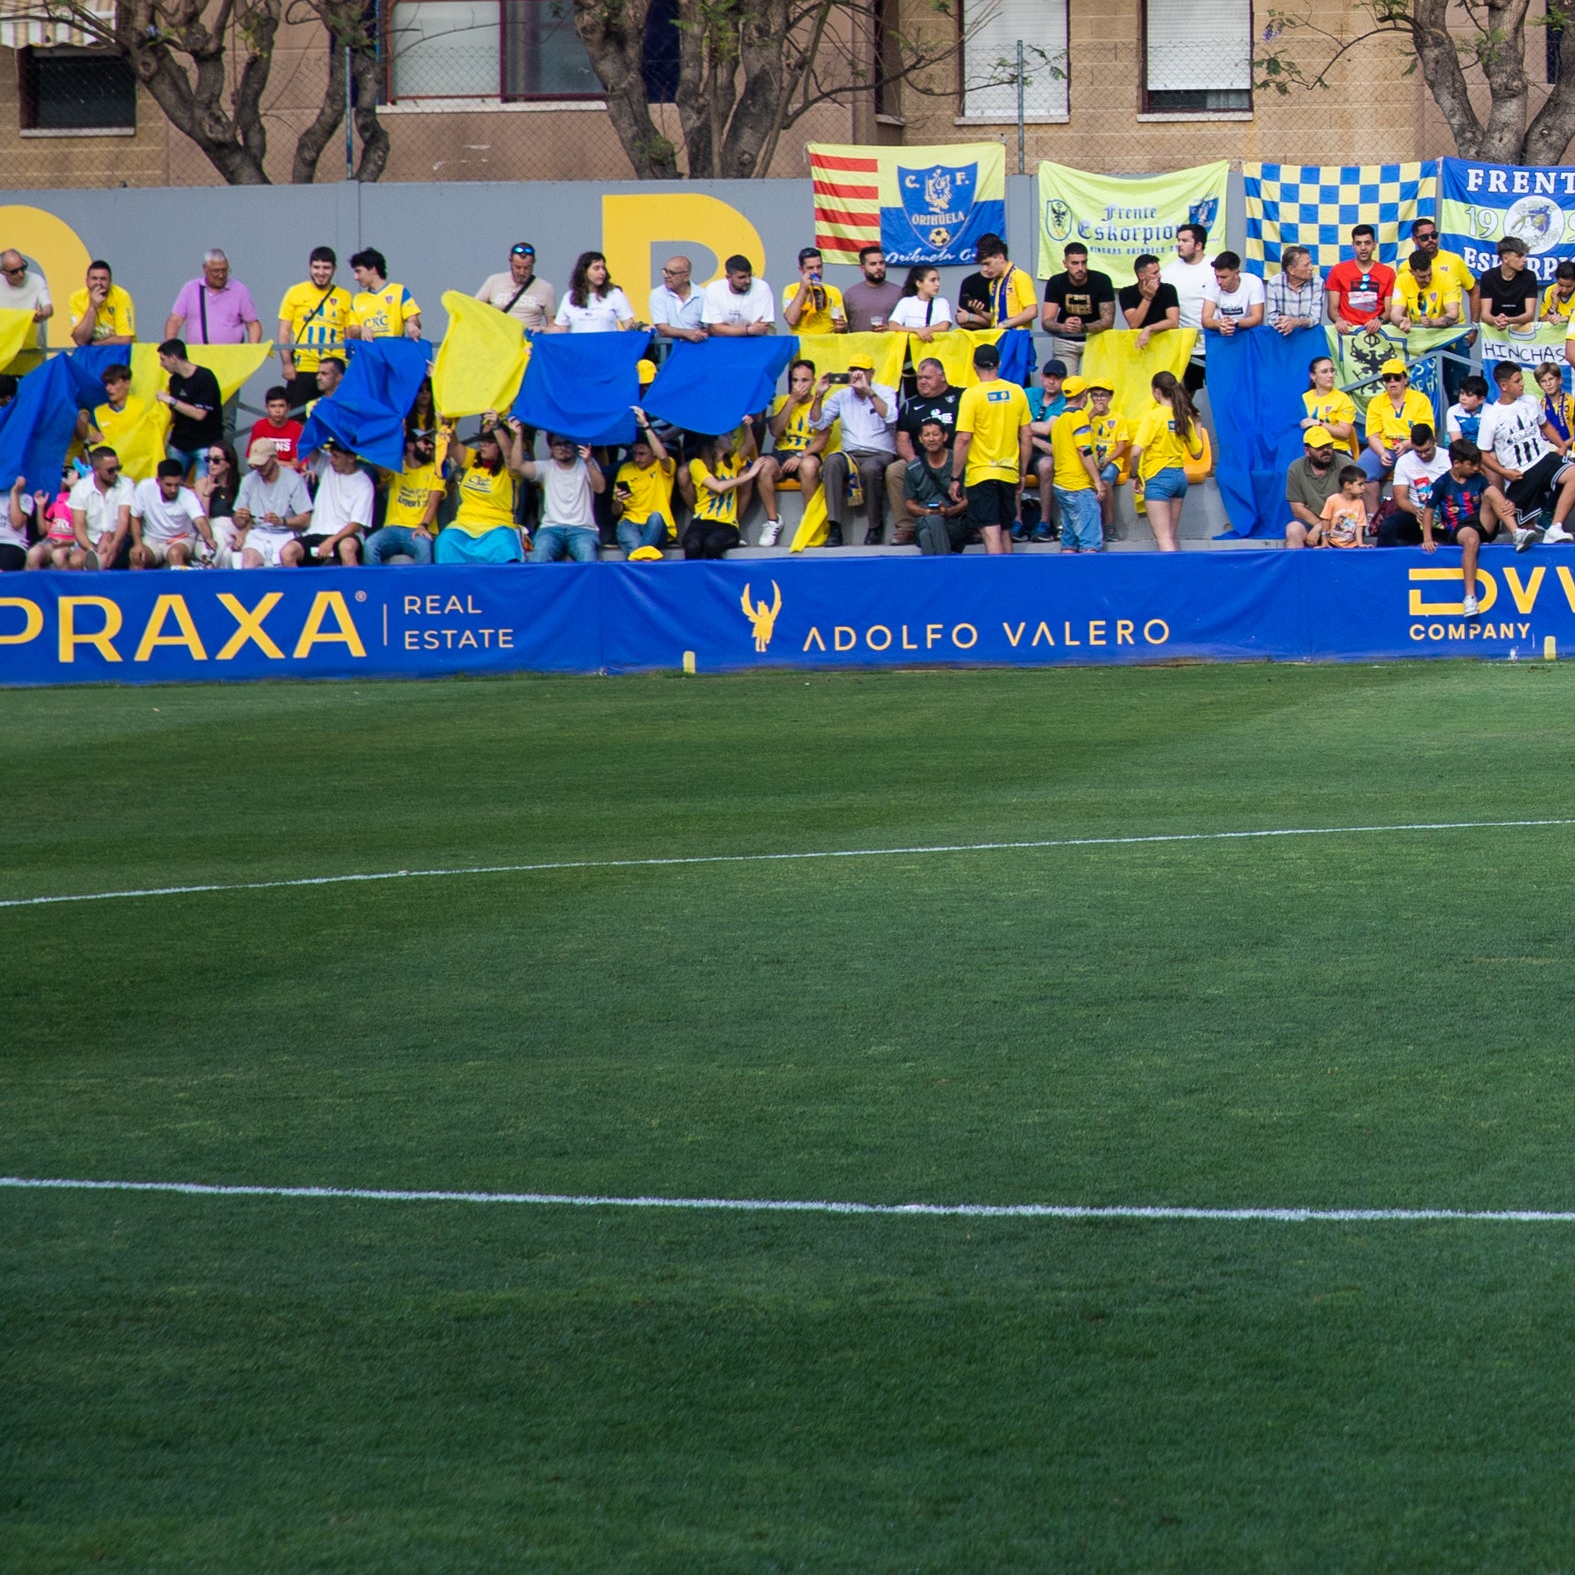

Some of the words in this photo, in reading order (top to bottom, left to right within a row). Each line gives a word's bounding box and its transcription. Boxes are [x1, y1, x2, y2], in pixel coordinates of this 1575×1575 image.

[911, 210, 965, 226] ORIHUELA
[1101, 203, 1158, 222] Frente
[1465, 206, 1499, 238] 19
[885, 246, 956, 265] Orihuela
[1484, 342, 1565, 363] HINCHAS
[404, 594, 482, 614] REAL
[404, 628, 514, 650] ESTATE
[803, 623, 978, 651] ADOLFO
[1002, 618, 1170, 647] VALERO
[1409, 622, 1531, 640] COMPANY
